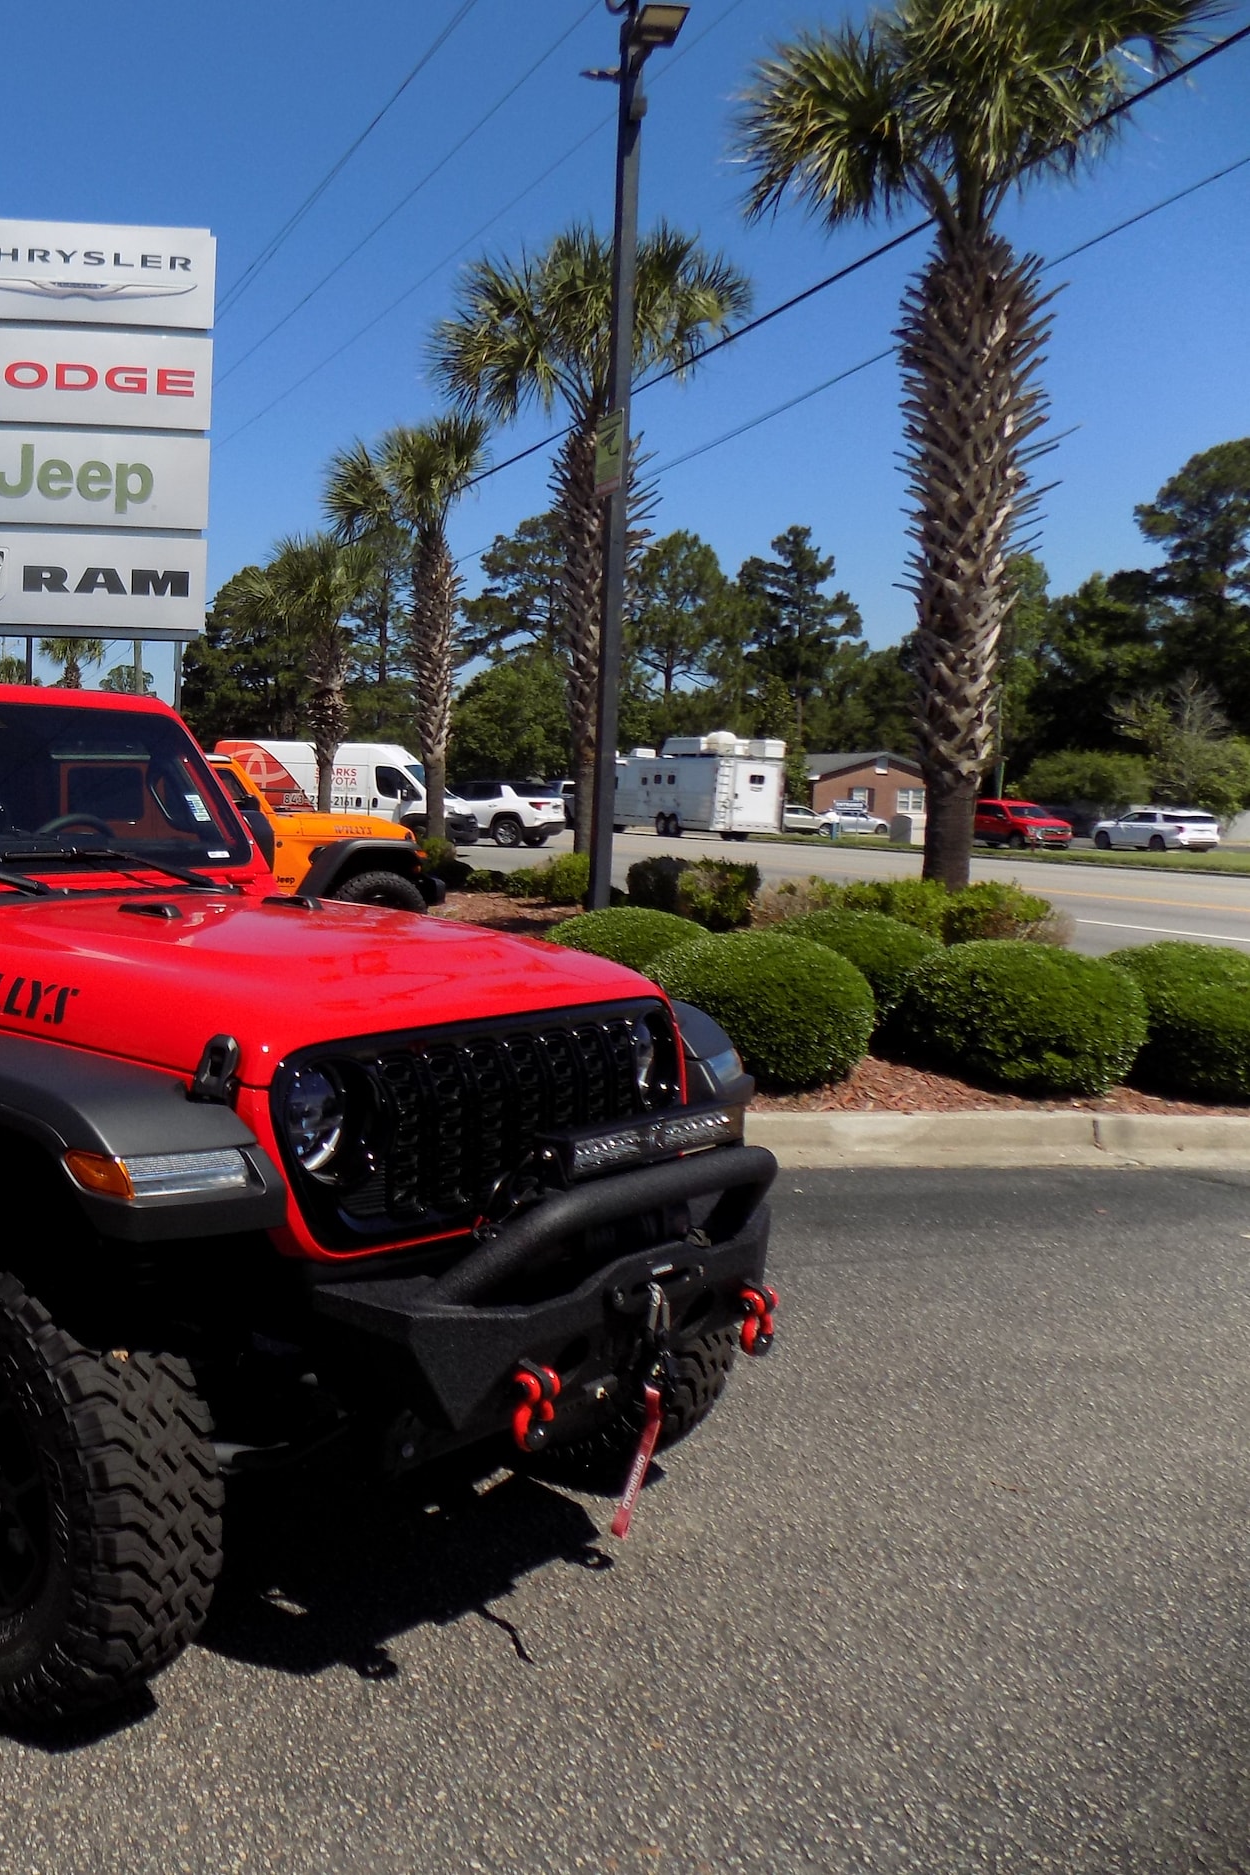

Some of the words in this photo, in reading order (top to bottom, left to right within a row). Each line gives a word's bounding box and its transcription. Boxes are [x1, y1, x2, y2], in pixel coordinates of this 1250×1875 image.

[22, 565, 190, 598] RAM
[315, 767, 357, 776] SARKS
[315, 776, 357, 785] TYOTA
[284, 795, 354, 807] 843-2-2161
[334, 825, 372, 835] WILLYS
[276, 876, 295, 884] Jeep
[622, 1454, 646, 1510] OPENROAD
